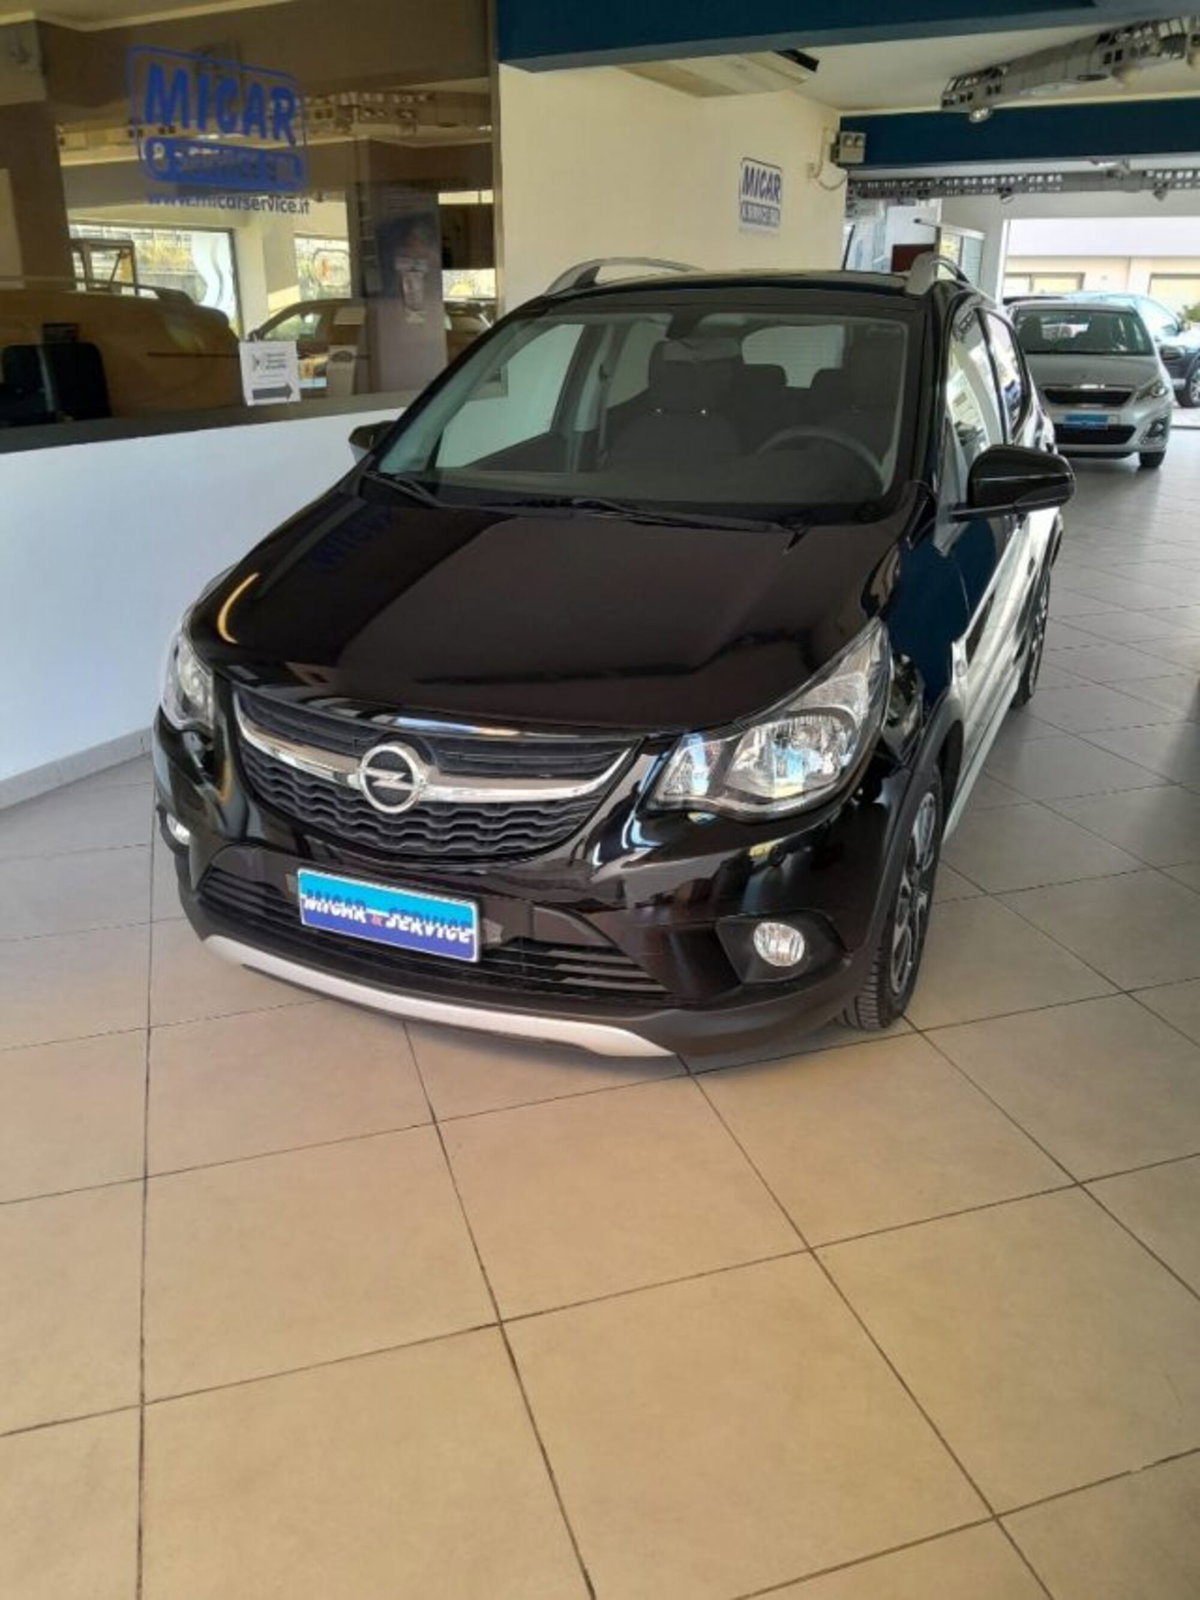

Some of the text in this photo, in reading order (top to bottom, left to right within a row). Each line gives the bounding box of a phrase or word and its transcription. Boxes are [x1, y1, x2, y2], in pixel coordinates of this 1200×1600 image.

[144, 62, 296, 147] MICAR
[743, 165, 780, 204] MICAR
[303, 888, 367, 924] MICAR
[386, 907, 471, 944] SERVICE
